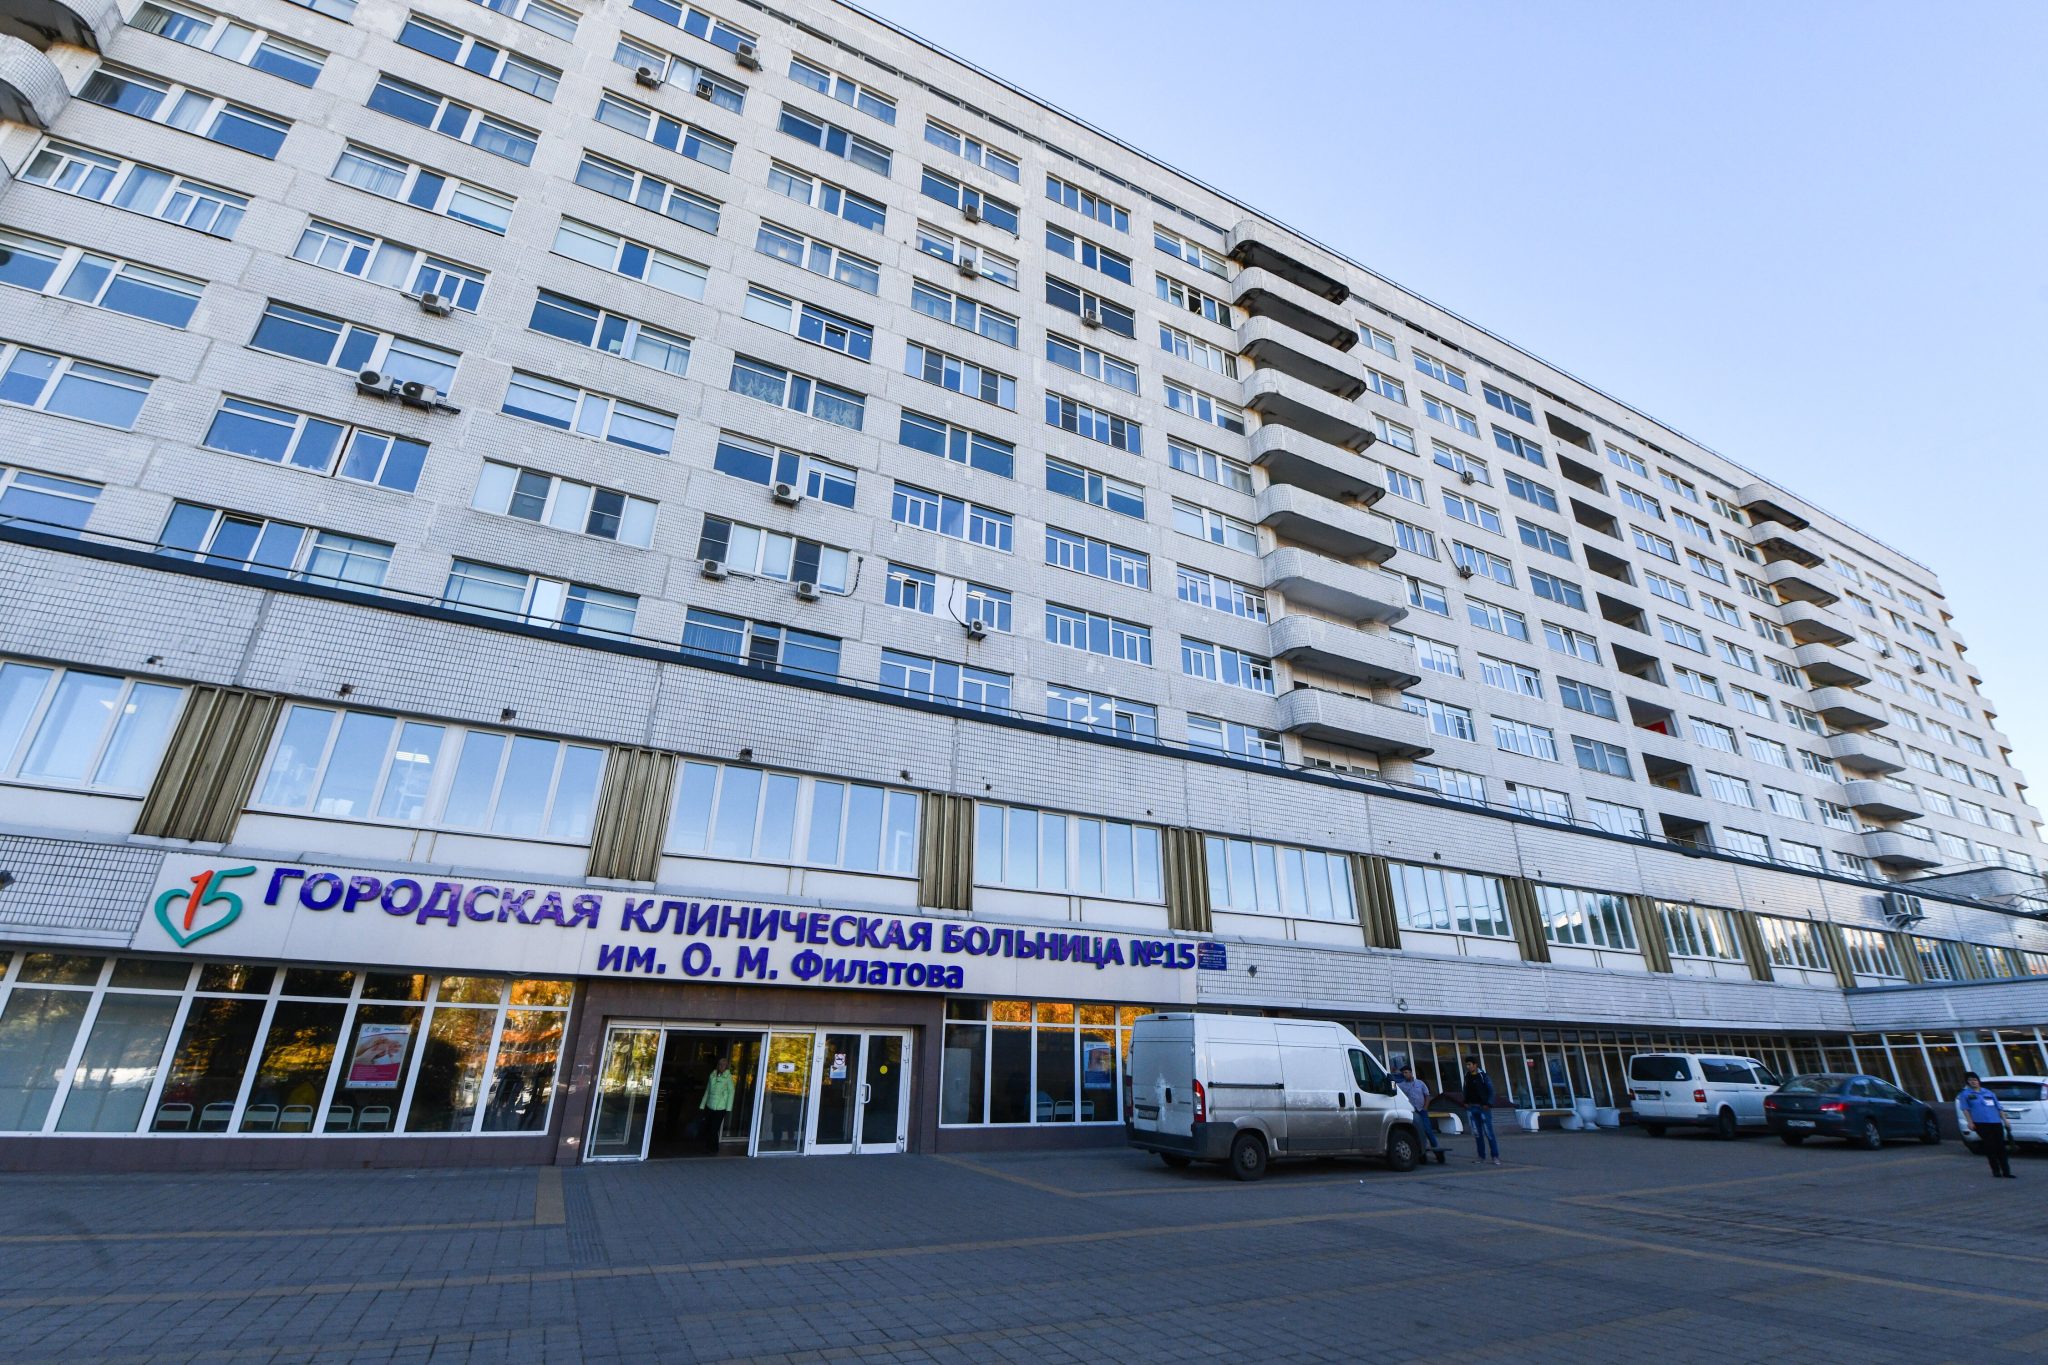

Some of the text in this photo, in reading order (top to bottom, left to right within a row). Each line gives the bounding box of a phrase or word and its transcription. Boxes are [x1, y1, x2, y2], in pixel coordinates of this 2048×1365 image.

[264, 867, 1196, 970] ГОРОДСКАЯ КЛИНИЧЕСКАЯ БОЛЬНИЦА №15
[597, 942, 965, 989] им. О. М. Филатова
